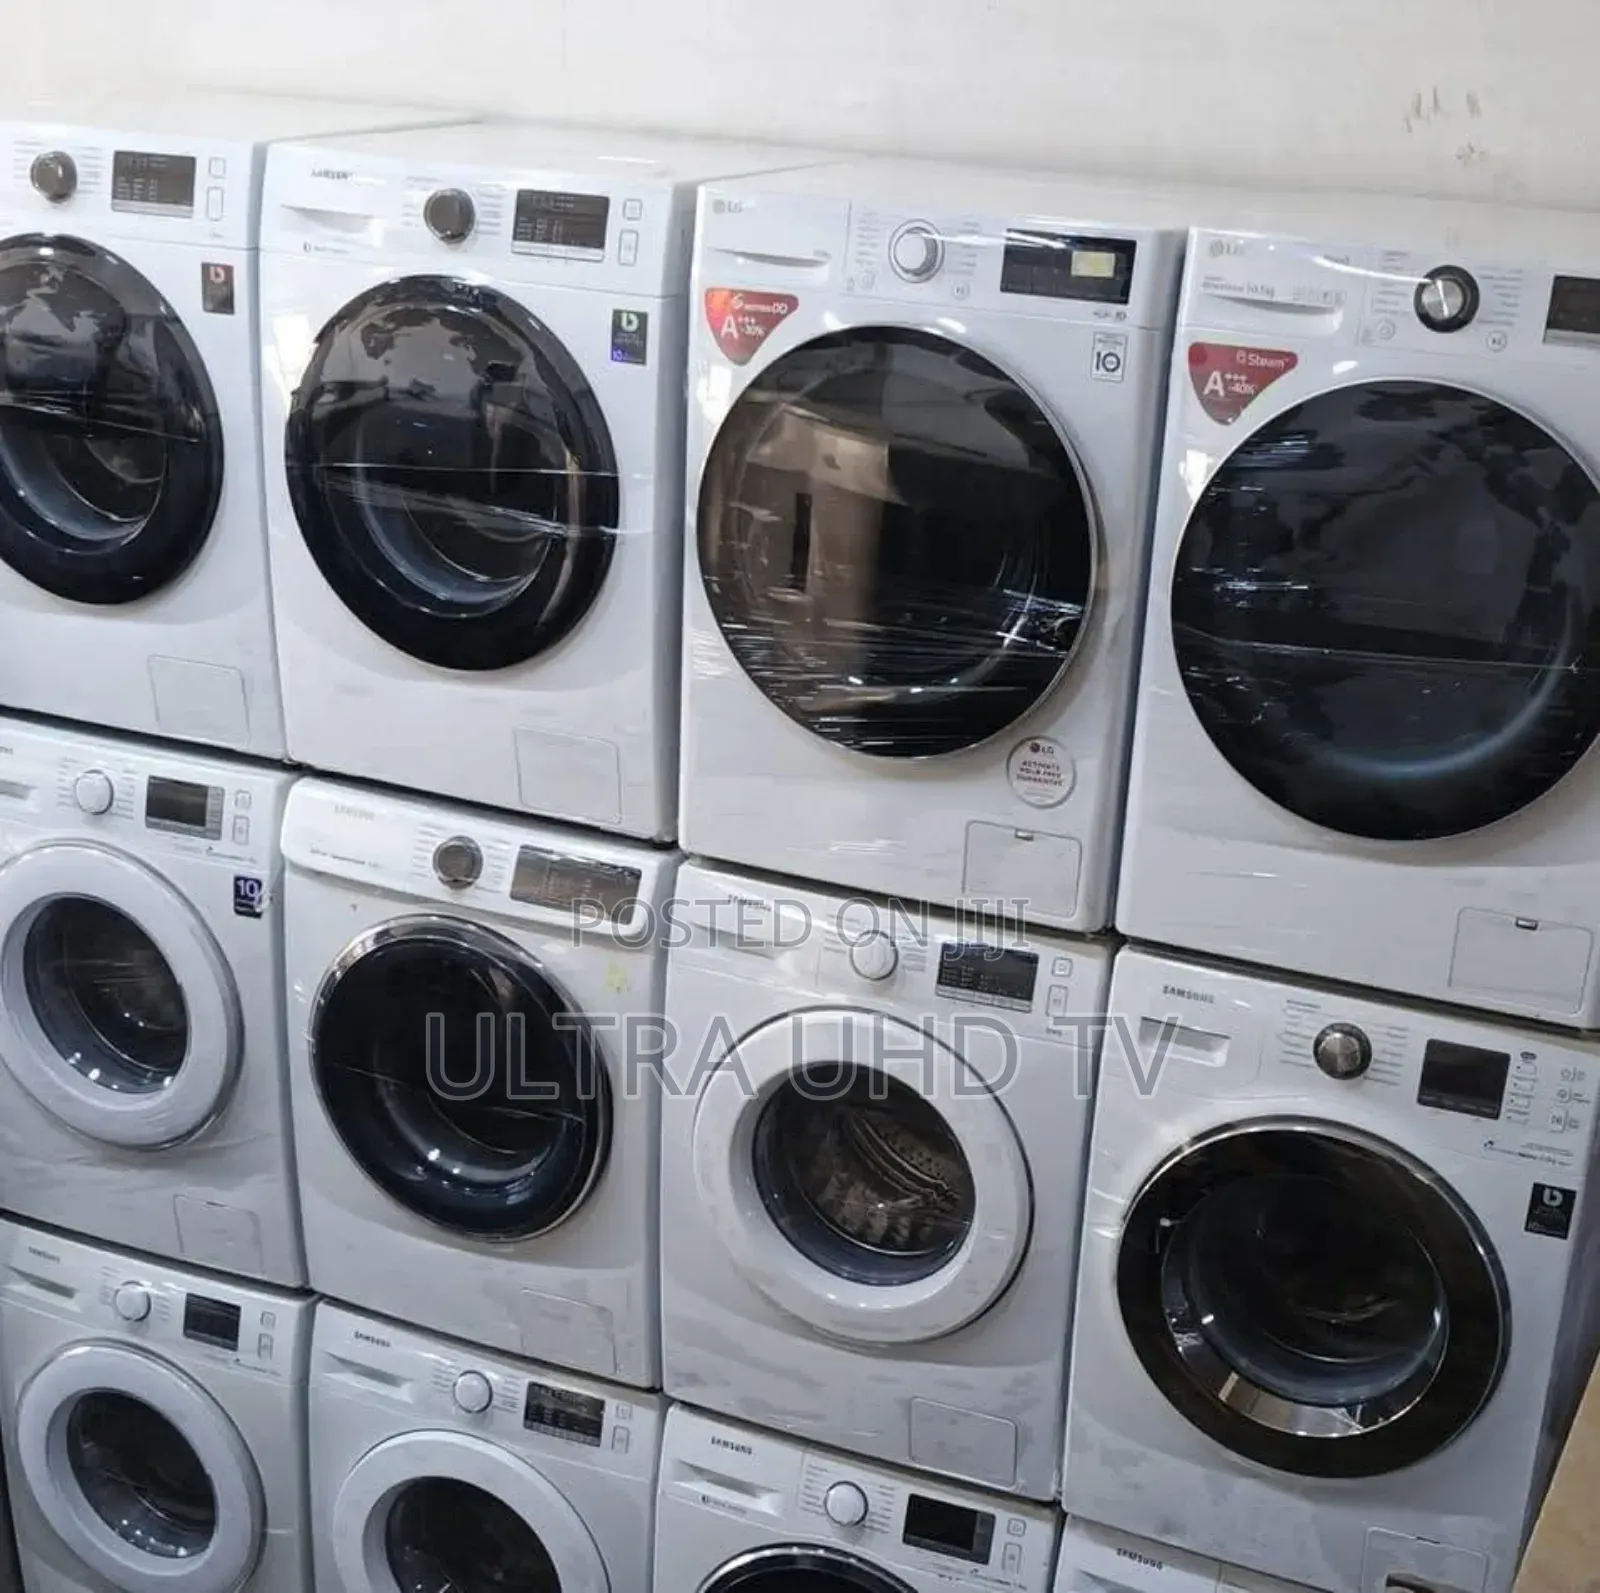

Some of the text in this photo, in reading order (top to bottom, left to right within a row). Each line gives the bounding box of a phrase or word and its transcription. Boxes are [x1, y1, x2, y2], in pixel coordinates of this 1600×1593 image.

[1162, 984, 1215, 1004] SAMSUNG
[710, 1435, 753, 1456] SAMSUNG
[1115, 1546, 1163, 1571] SAMSUNG
